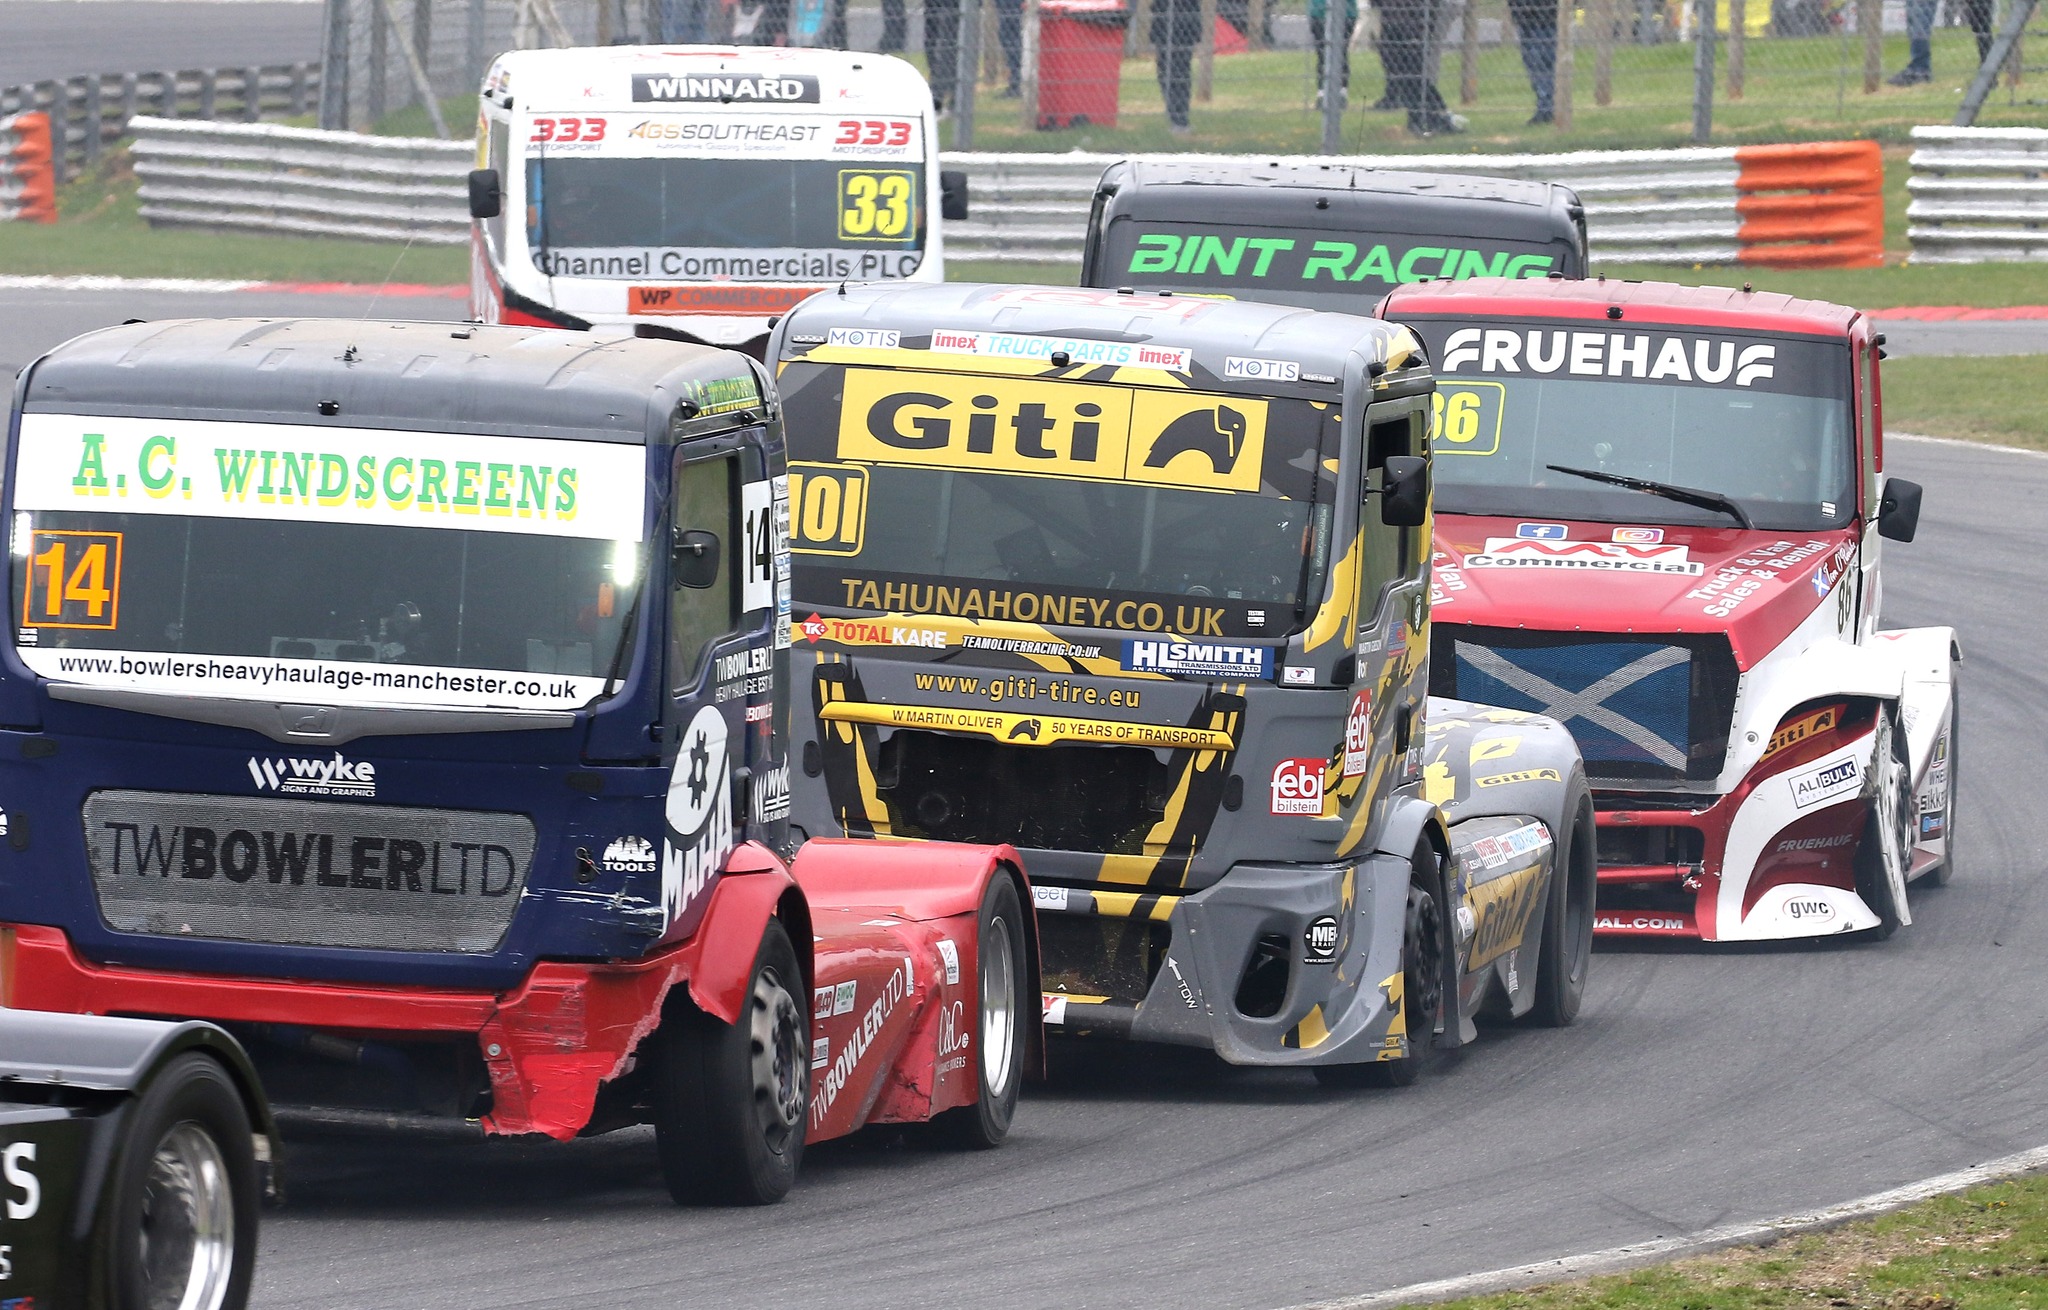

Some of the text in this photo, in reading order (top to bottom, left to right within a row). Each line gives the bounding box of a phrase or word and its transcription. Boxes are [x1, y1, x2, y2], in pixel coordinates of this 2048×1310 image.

[647, 77, 804, 100] WINNARD
[530, 118, 607, 142] 333
[834, 120, 911, 145] 333
[525, 144, 602, 152] MOTORSPORT
[832, 146, 907, 155] MOTORSPORT
[844, 175, 909, 236] 33
[532, 251, 918, 278] Channel Commercials PLC
[1128, 234, 1555, 284] BINT RACING
[640, 289, 671, 305] WP
[830, 330, 898, 348] MOTIS
[935, 332, 1182, 366] imex TRUCK PARTS imex
[1227, 359, 1297, 379] MOTIS
[1442, 327, 1776, 387] FRUEHAUF
[866, 392, 1103, 463] Giti
[214, 447, 579, 521] WINDSCREENS
[746, 507, 771, 584] 14
[1468, 555, 1697, 574] Commercial
[1686, 539, 1797, 601] Truck & Van
[1703, 539, 1831, 618] Sales & Rental
[35, 543, 110, 618] 14
[842, 579, 1225, 637] TAHUNAHONEY.CO.UK
[1838, 569, 1851, 634] 86
[832, 622, 947, 649] TOTALKARE
[961, 635, 1102, 658] TEAMOLIVERRACING.CO.UK
[59, 656, 577, 699] www.bowlersheavyhaulage-manchester.co.uk
[1180, 662, 1243, 671] TRANSMISSIONS
[914, 672, 1141, 709] www.giti-tire.eu
[893, 710, 1003, 728] W MARTIN OLIVER
[1051, 722, 1217, 745] 50 YEARS OF TRANSPORT
[1346, 695, 1371, 751] febi
[1764, 724, 1804, 755] Giti
[288, 751, 375, 786] wyke
[1270, 760, 1324, 798] febi
[1483, 772, 1530, 785] Giti
[280, 785, 376, 797] SIGNS AND GRAPHICS
[1277, 801, 1318, 813] bilstein
[660, 752, 732, 938] MAHA
[1777, 833, 1853, 852] FRUEHAUF
[105, 821, 516, 898] TWBOWLERLTD
[602, 861, 656, 872] TOOLS
[1790, 902, 1829, 919] gwc
[1177, 980, 1198, 1009] TOW
[810, 967, 904, 1130] TWBOWLERLTD
